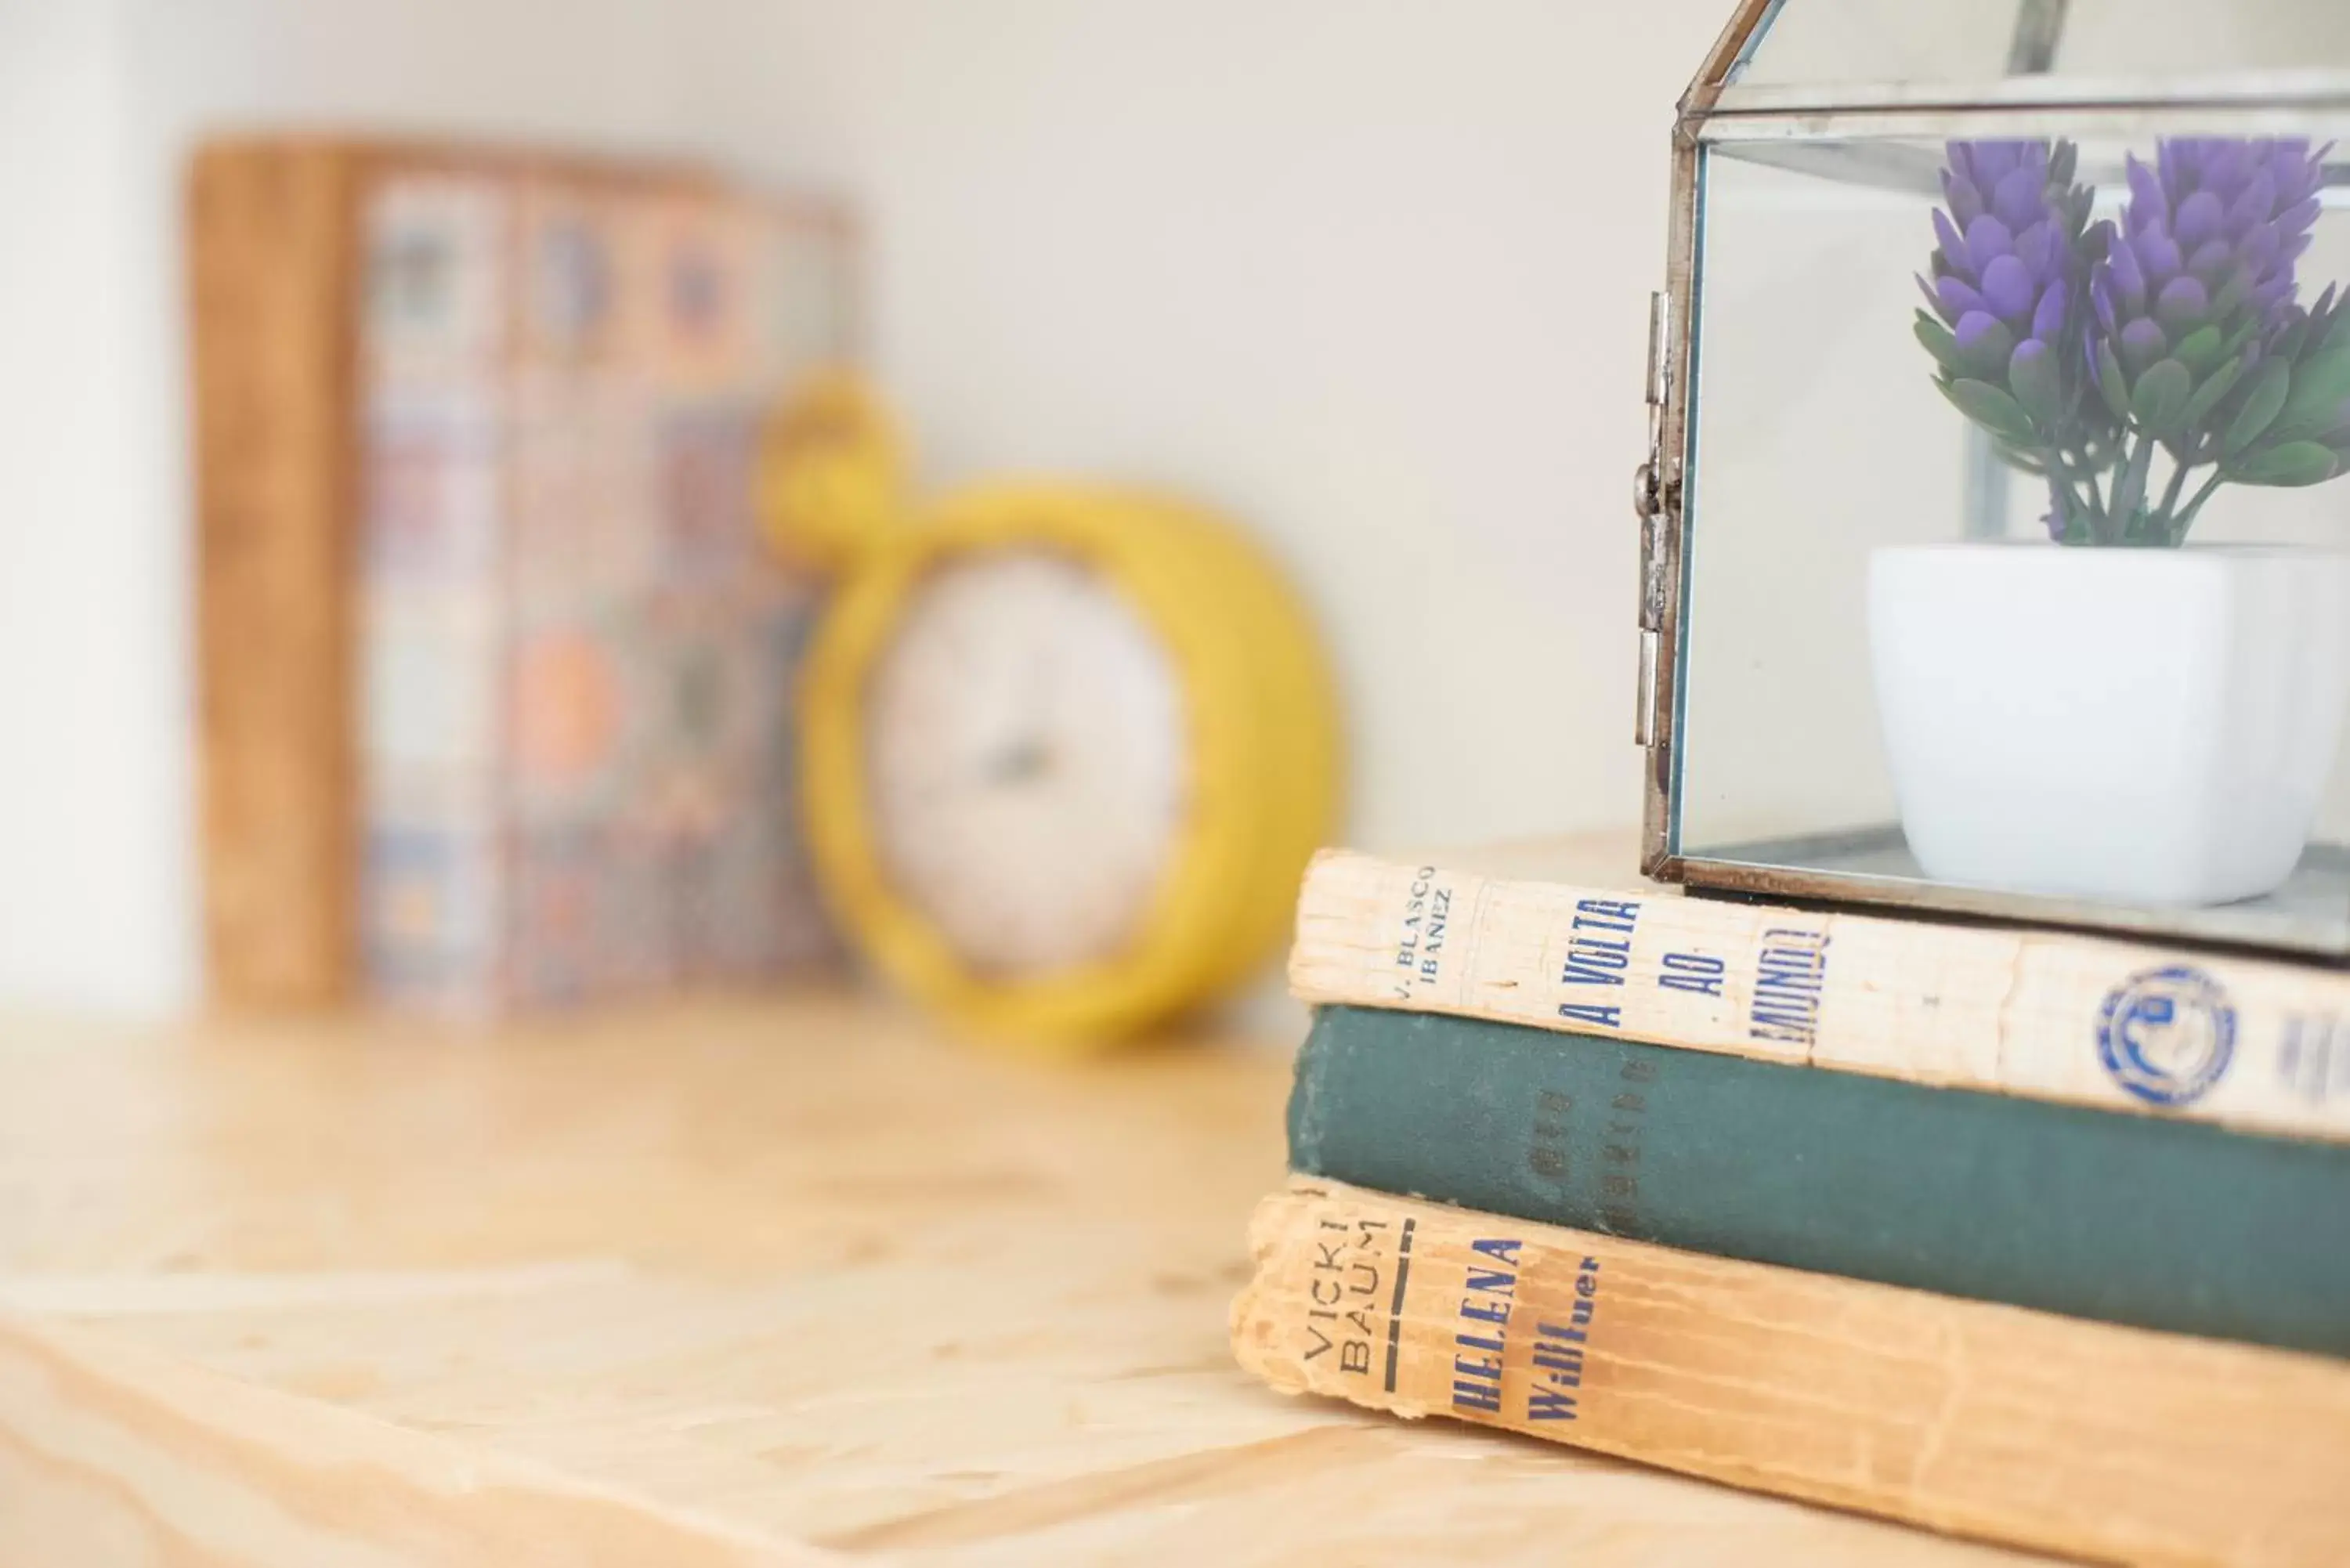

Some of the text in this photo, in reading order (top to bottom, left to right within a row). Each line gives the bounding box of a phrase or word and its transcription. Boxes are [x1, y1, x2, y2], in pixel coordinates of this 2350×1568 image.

[1397, 865, 1436, 969] BLASCO
[1561, 898, 1642, 987] VOLTA
[1658, 952, 1724, 998] AO
[1557, 1001, 1621, 1028] A
[1749, 927, 1831, 1044] MUNDO
[1303, 1219, 1349, 1362] VICKI
[1340, 1219, 1387, 1375] BAUM
[1452, 1238, 1523, 1413] HELENA
[1528, 1255, 1600, 1421] Willfuer
